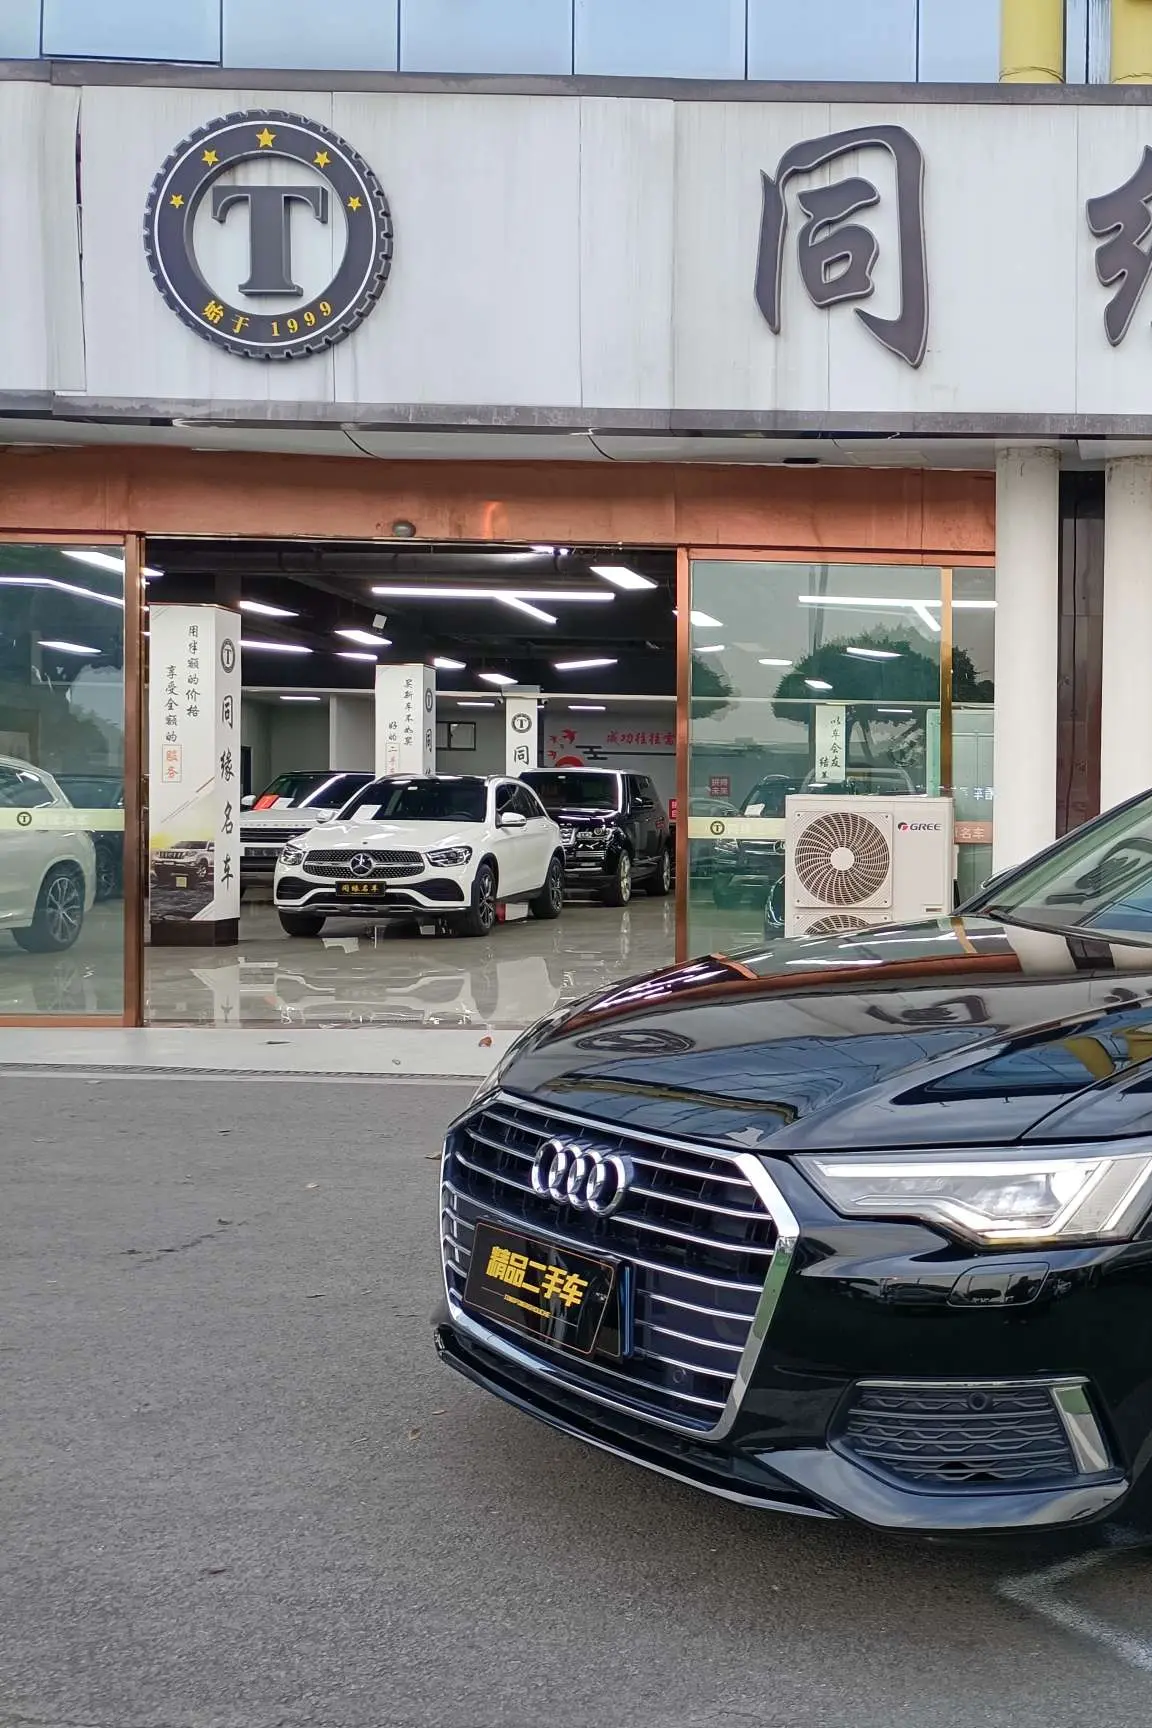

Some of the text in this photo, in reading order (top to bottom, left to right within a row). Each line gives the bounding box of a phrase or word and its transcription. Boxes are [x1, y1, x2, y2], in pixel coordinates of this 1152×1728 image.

[211, 185, 329, 297] T
[202, 300, 333, 337] 始于 1999
[513, 745, 530, 766] 同
[220, 694, 236, 891] 同缘名车
[909, 823, 942, 831] GREE
[485, 1245, 589, 1308] 精品二手车
